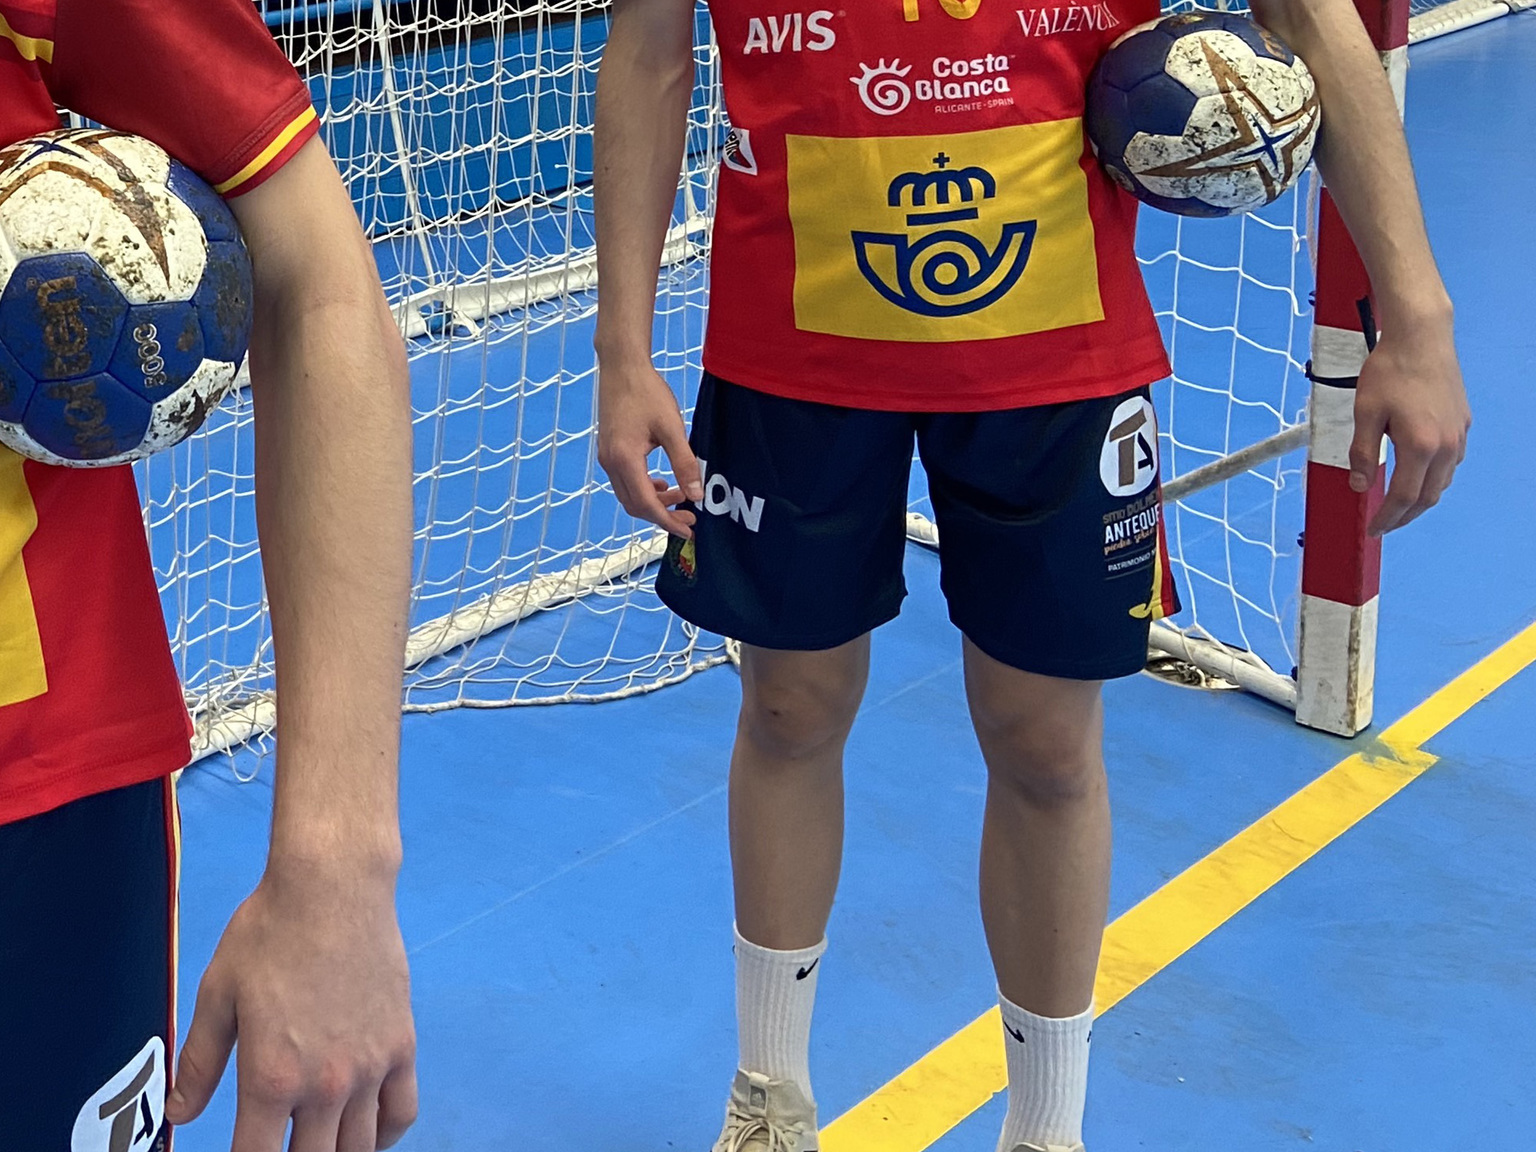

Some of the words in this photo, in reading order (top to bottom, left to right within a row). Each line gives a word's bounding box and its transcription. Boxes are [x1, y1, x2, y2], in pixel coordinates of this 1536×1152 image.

[743, 10, 836, 55] AVIS
[932, 53, 1009, 78] Costa
[915, 76, 1011, 100] Blanca
[934, 102, 982, 114] ALICANTE
[988, 97, 1014, 108] SPAIN
